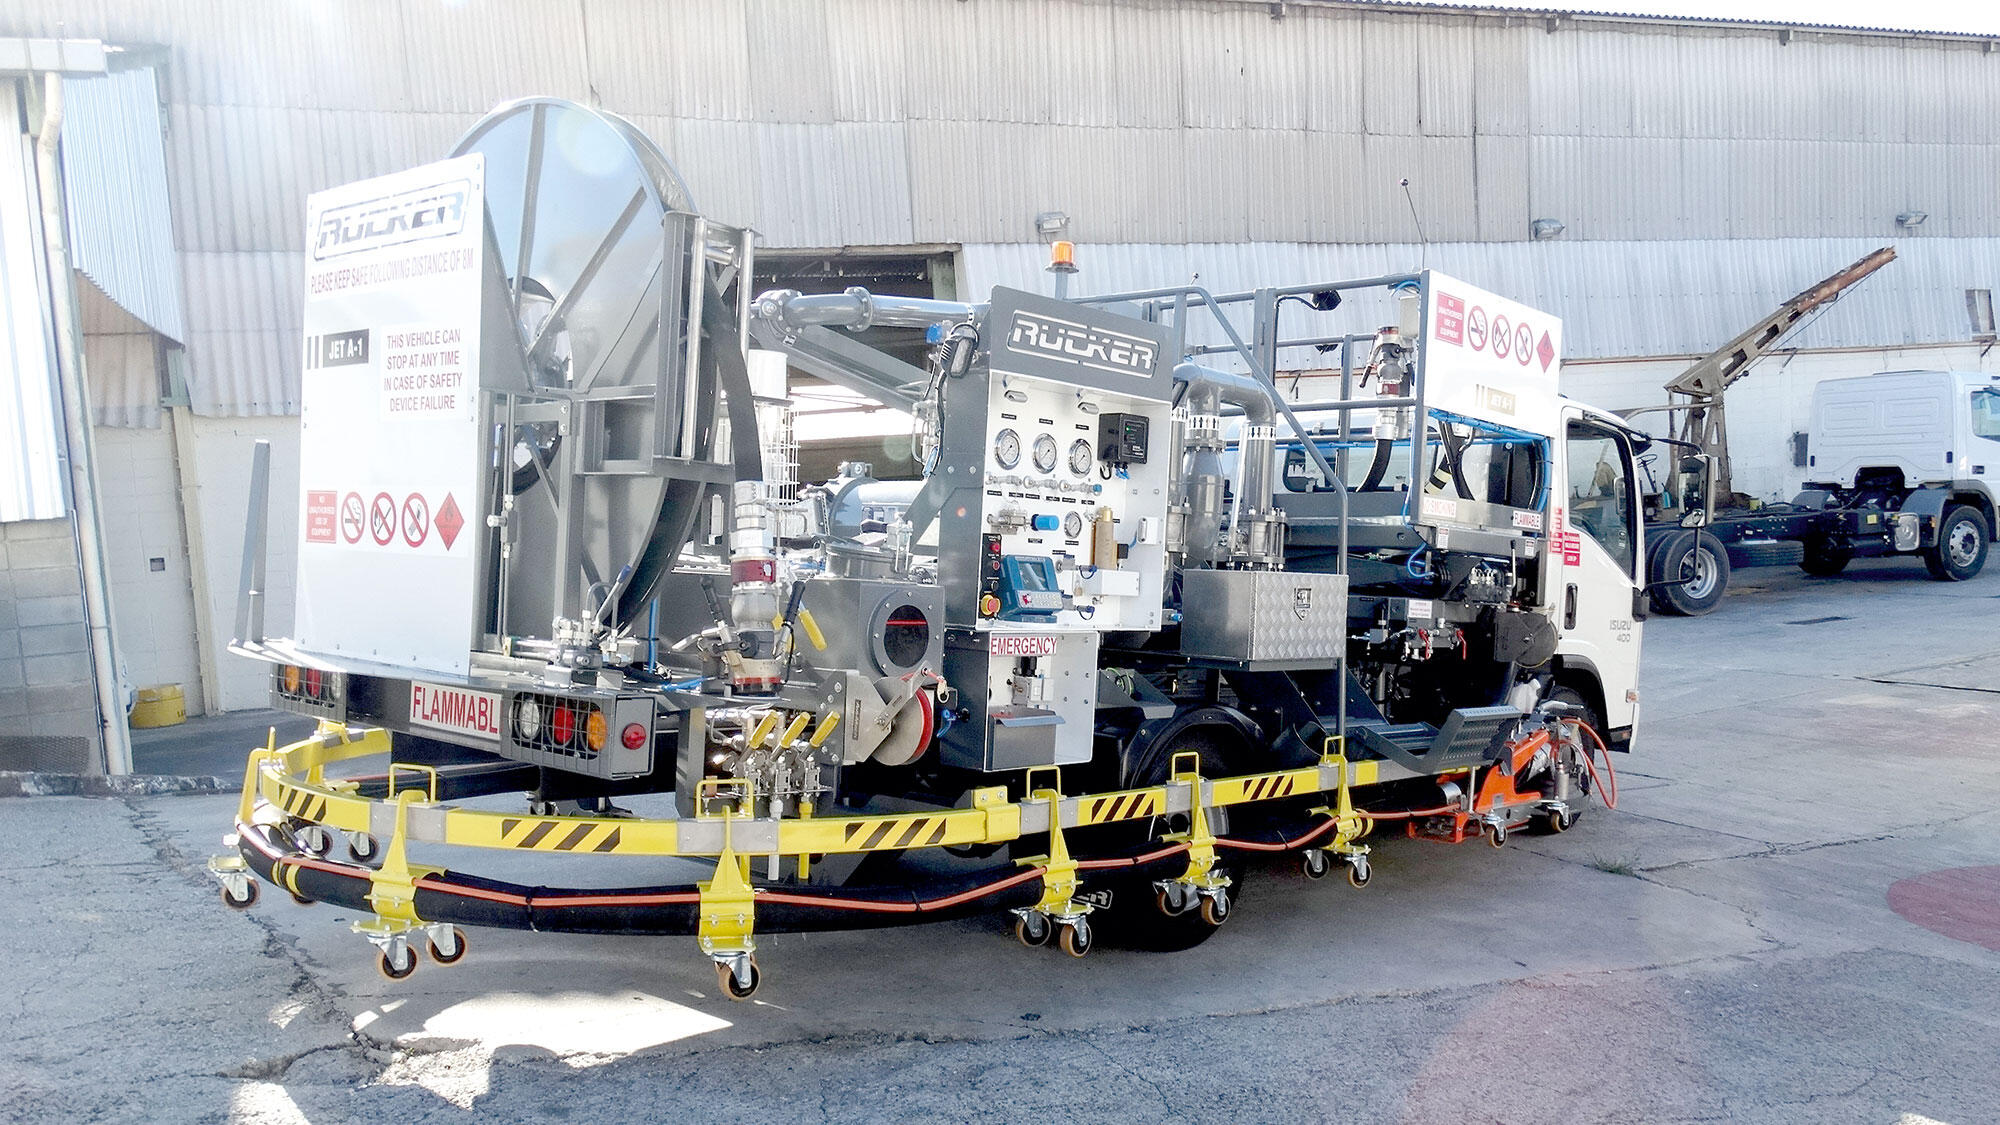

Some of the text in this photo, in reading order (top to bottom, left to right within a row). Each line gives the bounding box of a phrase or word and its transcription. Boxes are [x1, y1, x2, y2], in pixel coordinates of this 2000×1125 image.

[311, 271, 334, 294] PLEASE
[334, 268, 350, 290] KEEP
[351, 265, 368, 288] SAFE
[369, 257, 410, 285] FOLLOWING
[411, 251, 448, 277] DISTANCE
[450, 250, 460, 272] OF
[328, 337, 363, 360] JET A-1
[387, 328, 461, 349] THIS VEHICLE CAN
[387, 350, 460, 370] STOP AT ANY TIME
[384, 372, 463, 391] IN CASE OF SAFETY
[389, 395, 456, 412] DEVICE FAILURE
[1609, 619, 1632, 631] ISUZU
[991, 637, 1057, 655] EMERGENCY
[412, 685, 502, 734] FLAMMABL
